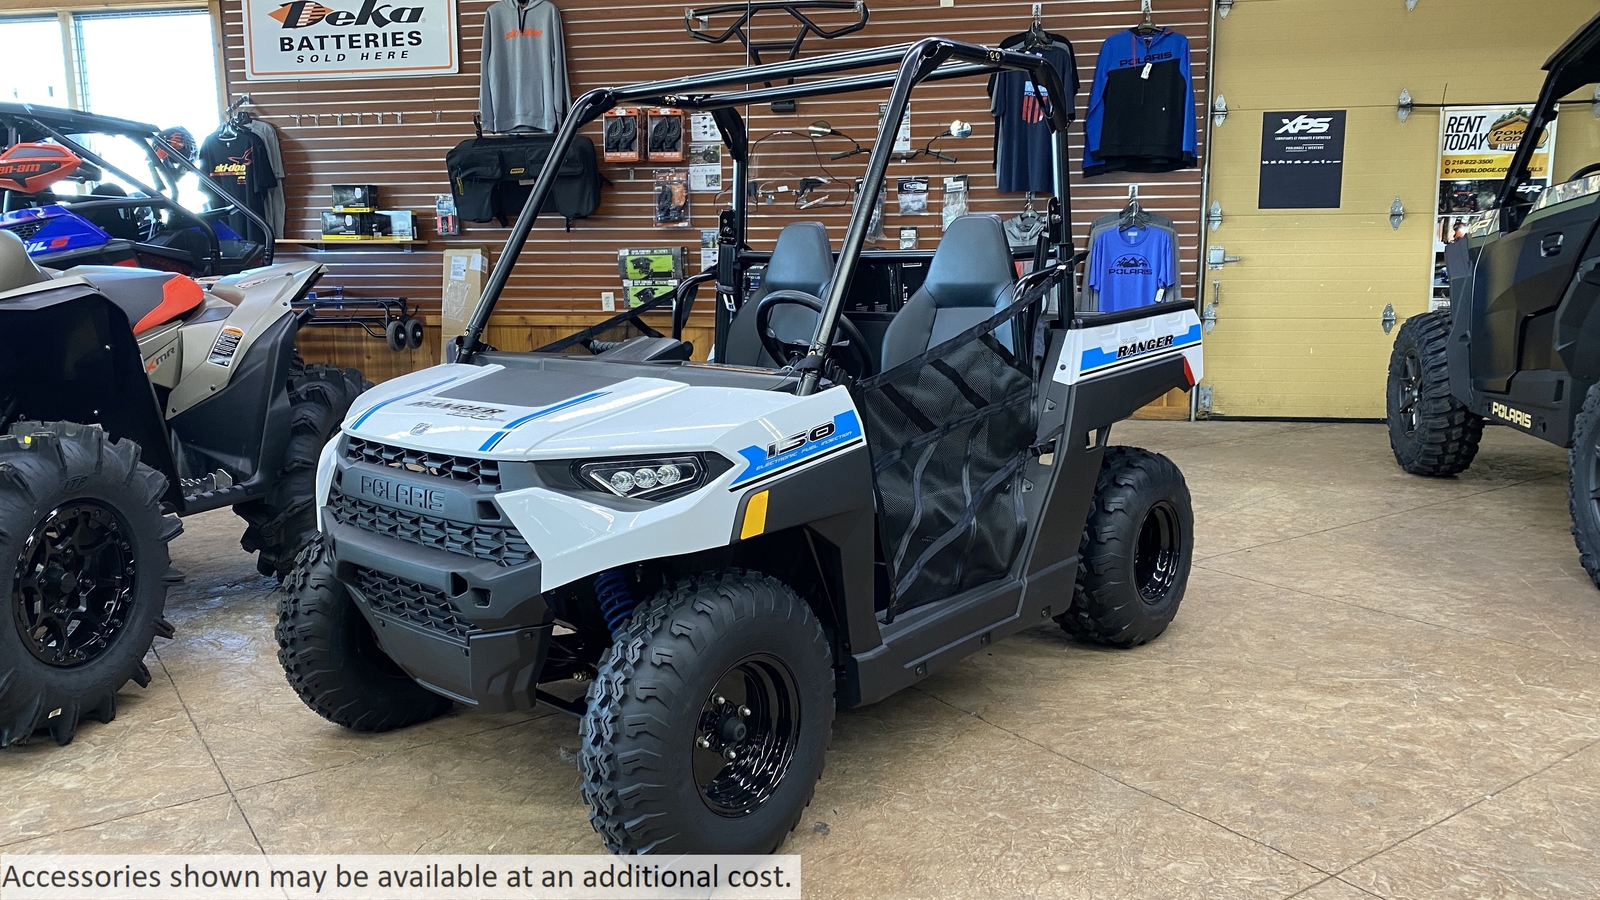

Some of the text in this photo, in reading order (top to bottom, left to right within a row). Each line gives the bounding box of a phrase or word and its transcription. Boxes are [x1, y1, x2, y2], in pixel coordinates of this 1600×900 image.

[279, 0, 425, 29] Deka
[279, 30, 423, 52] BATTERIES
[296, 50, 410, 64] SOLD HERE
[1119, 51, 1173, 67] POLARIS
[1274, 115, 1333, 134] XPS
[1445, 115, 1487, 134] RENT
[1443, 133, 1489, 151] TODAY
[214, 163, 246, 172] ski-doo
[1108, 268, 1153, 276] POLARIS
[1117, 335, 1174, 360] RANGER
[1492, 402, 1532, 428] POLARIS
[766, 421, 836, 460] 150
[756, 431, 853, 471] ELECTRONIC FUEL INJECTION
[361, 476, 445, 512] POLARIS
